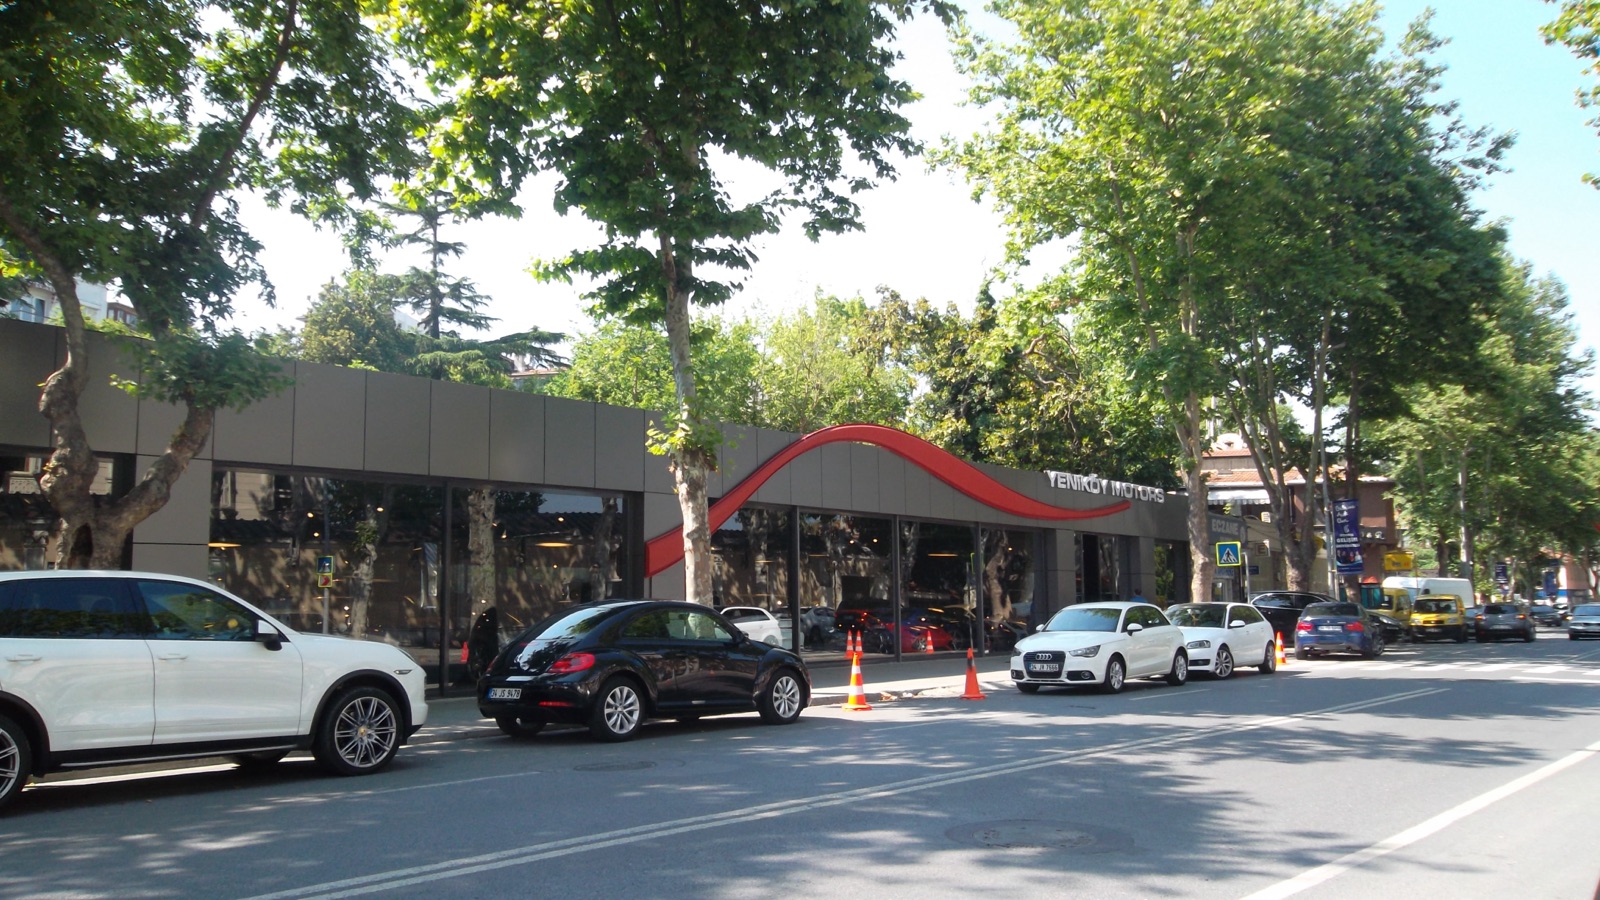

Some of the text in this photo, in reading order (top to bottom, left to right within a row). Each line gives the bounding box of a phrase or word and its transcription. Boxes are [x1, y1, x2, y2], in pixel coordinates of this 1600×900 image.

[1111, 480, 1165, 503] MOTORS
[1211, 518, 1239, 536] ECZANE
[491, 689, 498, 698] 34
[499, 689, 506, 698] JS
